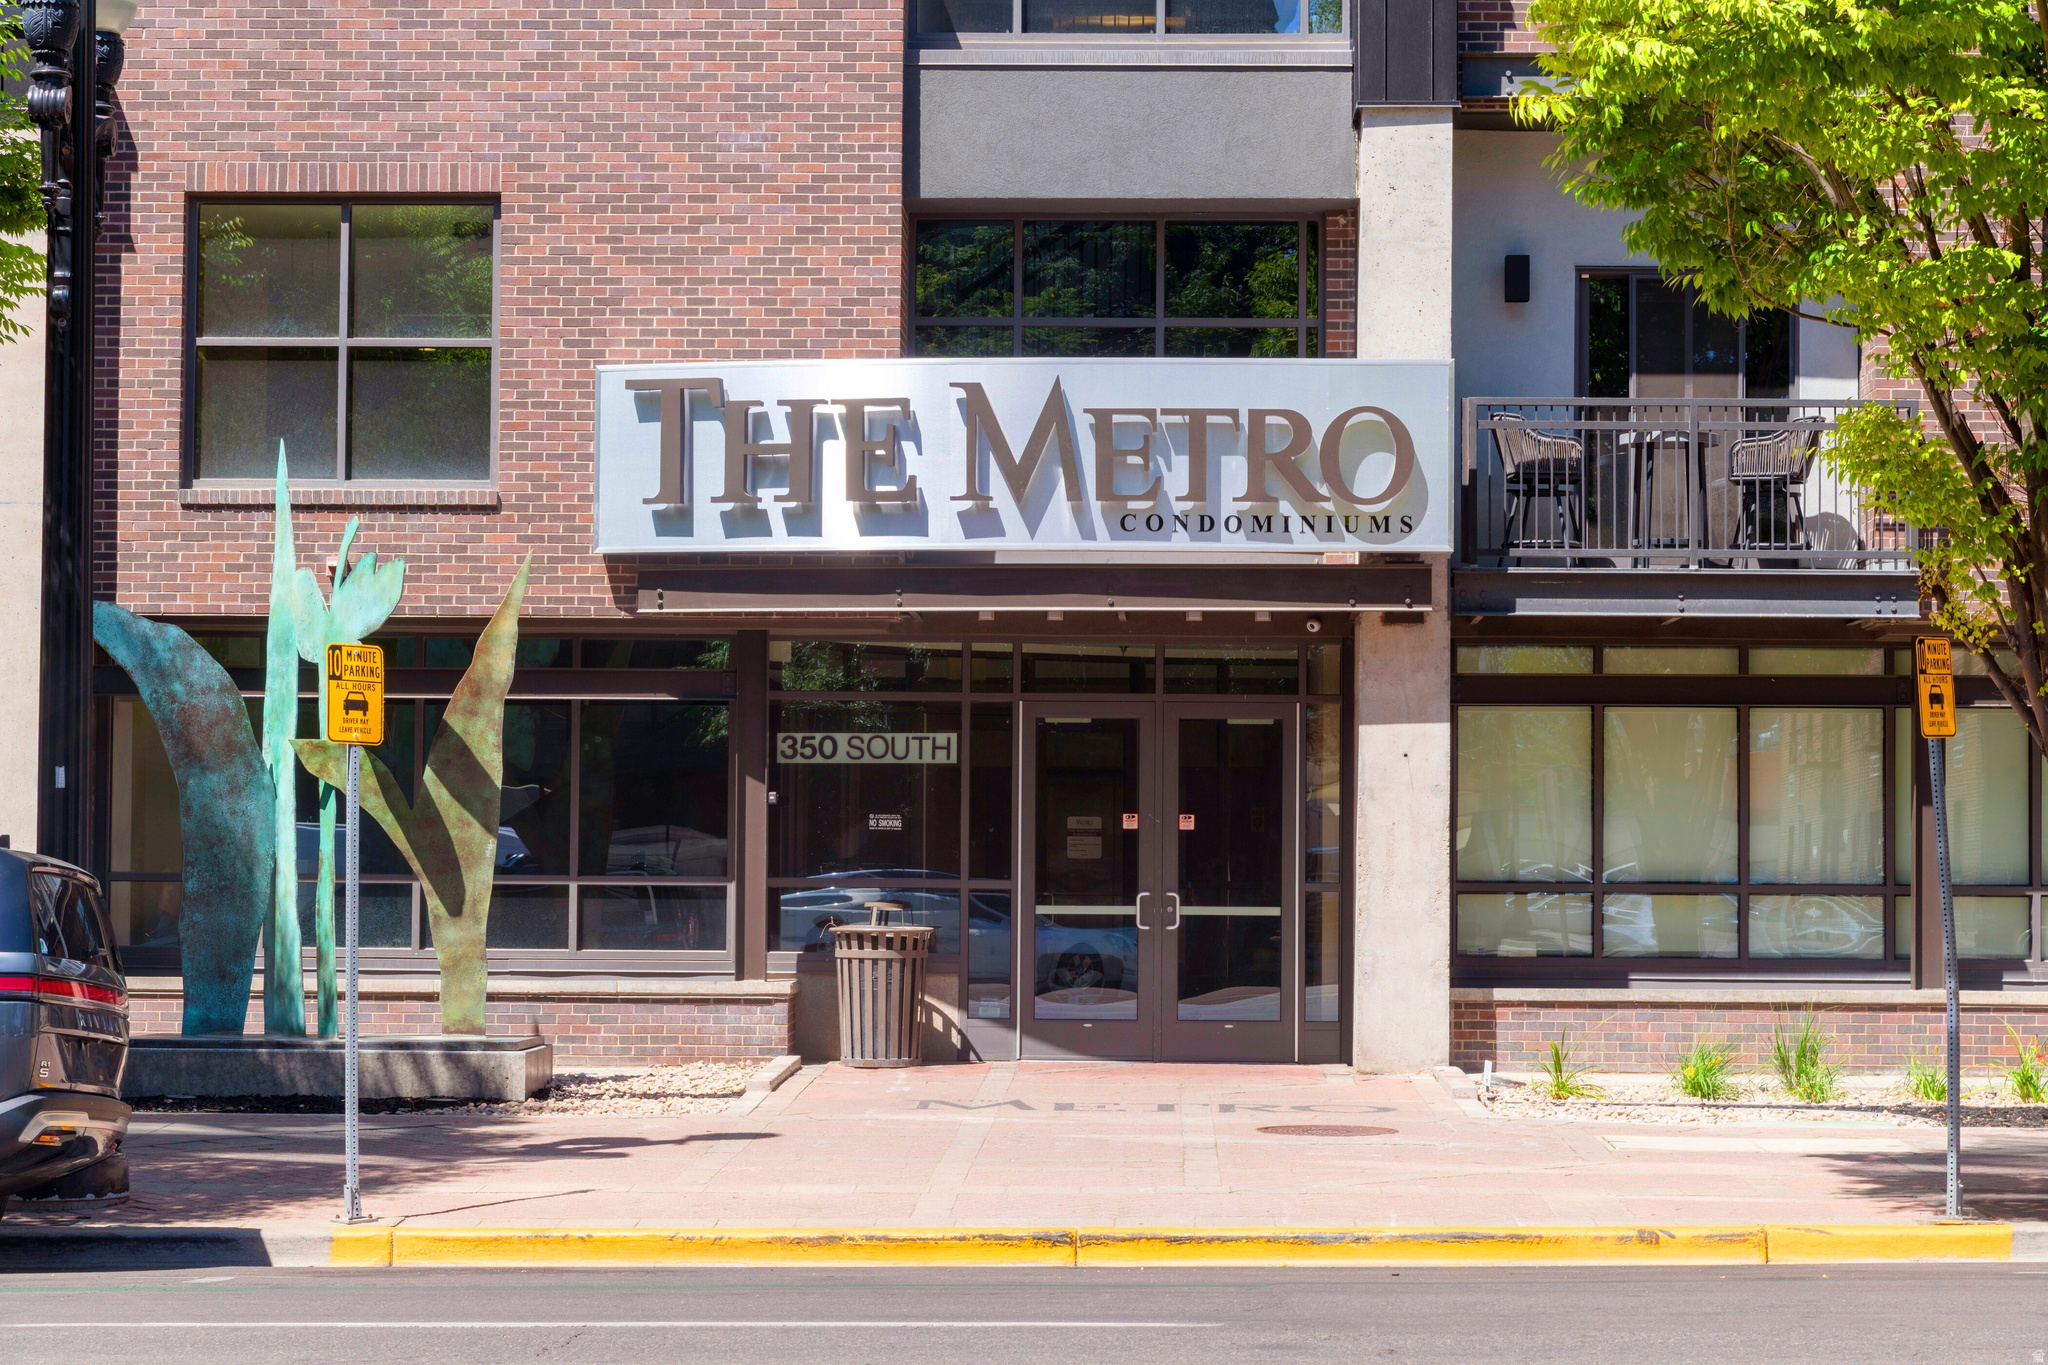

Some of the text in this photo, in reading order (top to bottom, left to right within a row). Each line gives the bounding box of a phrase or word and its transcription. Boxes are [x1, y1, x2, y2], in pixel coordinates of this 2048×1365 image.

[625, 375, 1415, 506] THE METRO
[1120, 513, 1415, 534] CONDOMINIUMS
[1927, 643, 1947, 656] MINUTE
[329, 649, 341, 677] 10
[346, 650, 377, 664] MINUTE
[1918, 643, 1926, 671] 10
[1926, 658, 1950, 671] PARKING
[344, 665, 380, 679] PARKING
[335, 682, 376, 692] ALL HOURS
[1923, 676, 1931, 684] ALL
[342, 717, 358, 725] DRIVER
[354, 727, 372, 735] VEHICLE
[780, 735, 951, 760] 350 SOUTH
[869, 819, 902, 827] NO SMOKING
[914, 1099, 1398, 1114] METRO
